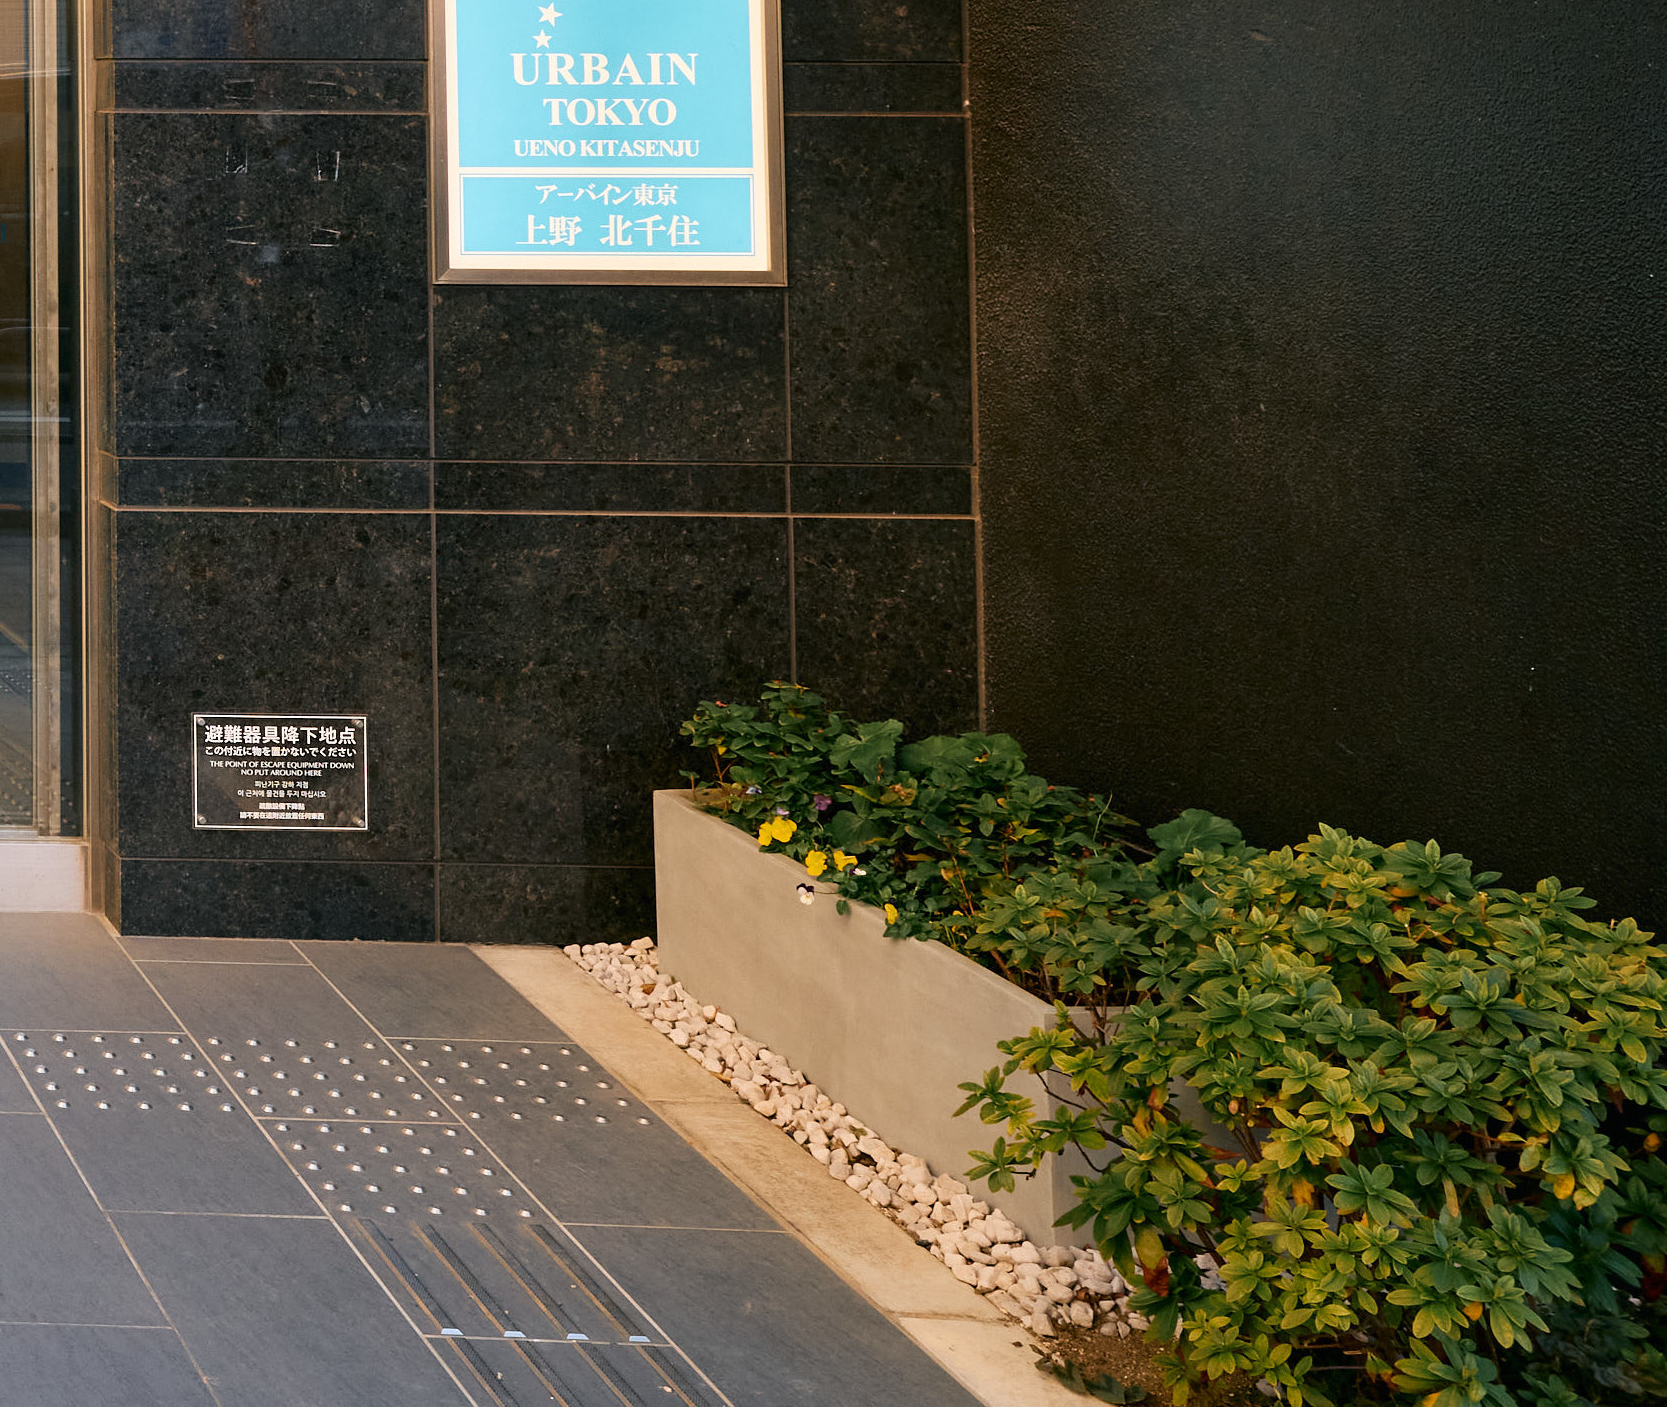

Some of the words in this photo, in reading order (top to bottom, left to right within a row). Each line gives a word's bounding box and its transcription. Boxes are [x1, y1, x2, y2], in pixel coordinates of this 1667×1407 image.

[510, 53, 699, 86] URBAIN
[543, 98, 677, 126] TOKYO
[514, 139, 576, 157] UENO
[579, 139, 700, 157] KITASENJU
[534, 183, 678, 206] アーバイン東京
[515, 215, 582, 247] 上野
[599, 215, 700, 247] 北千住
[204, 725, 357, 745] 避難器具降下地点
[205, 746, 357, 757] この付近に物を置かないでください
[287, 761, 328, 769] EQUIPMENT
